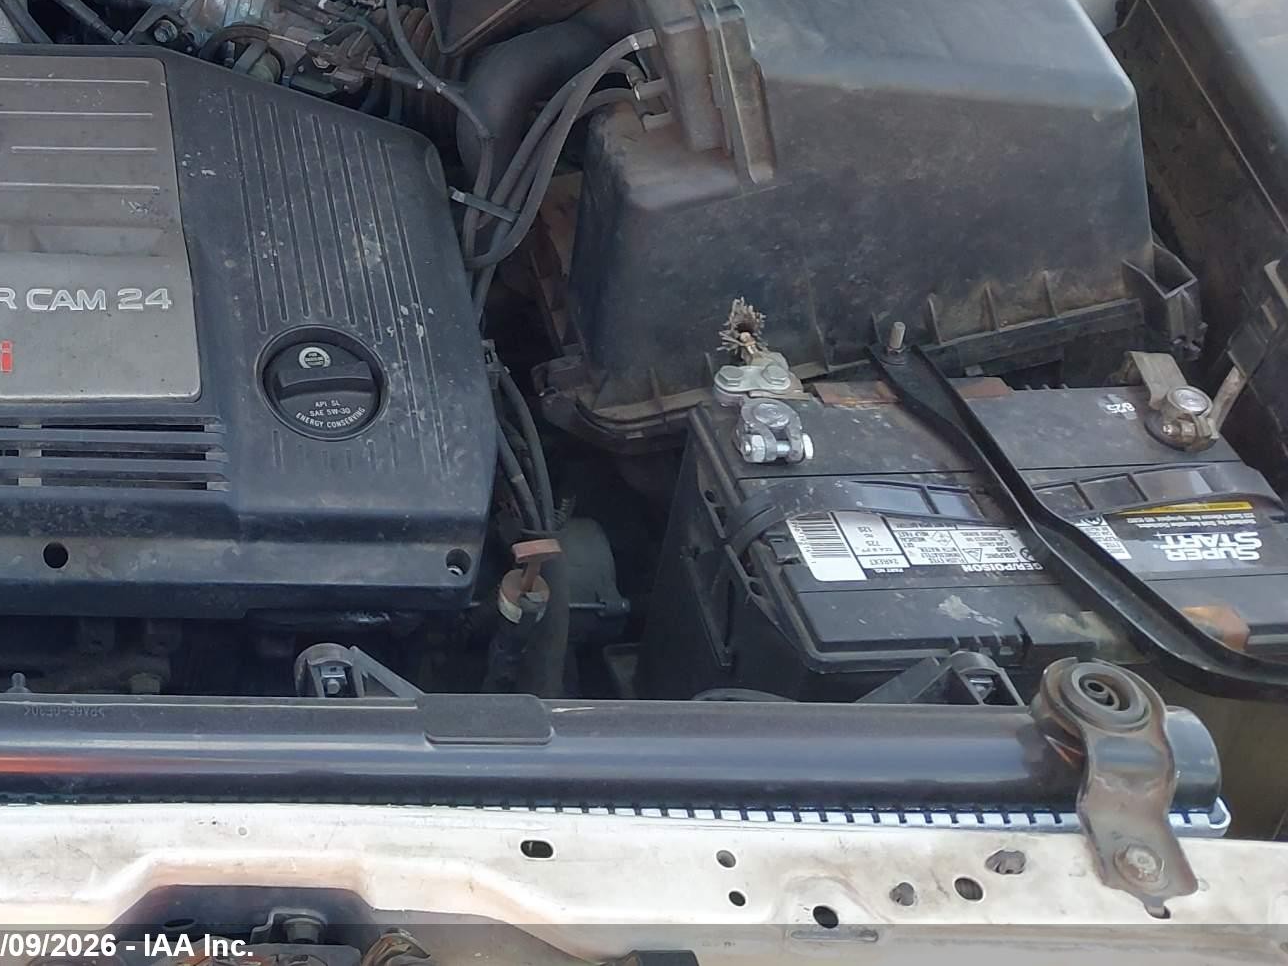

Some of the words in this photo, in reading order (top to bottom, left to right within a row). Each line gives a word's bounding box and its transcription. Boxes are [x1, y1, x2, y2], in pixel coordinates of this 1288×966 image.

[26, 287, 107, 312] CAM
[117, 287, 173, 311] 24
[315, 400, 328, 408] API
[295, 412, 324, 427] ENERGY
[326, 407, 367, 429] CONSERVING
[326, 407, 351, 416] 5W-30
[1159, 531, 1262, 549] START
[1164, 547, 1260, 561] SUPER
[961, 562, 1044, 572] GER/POISON
